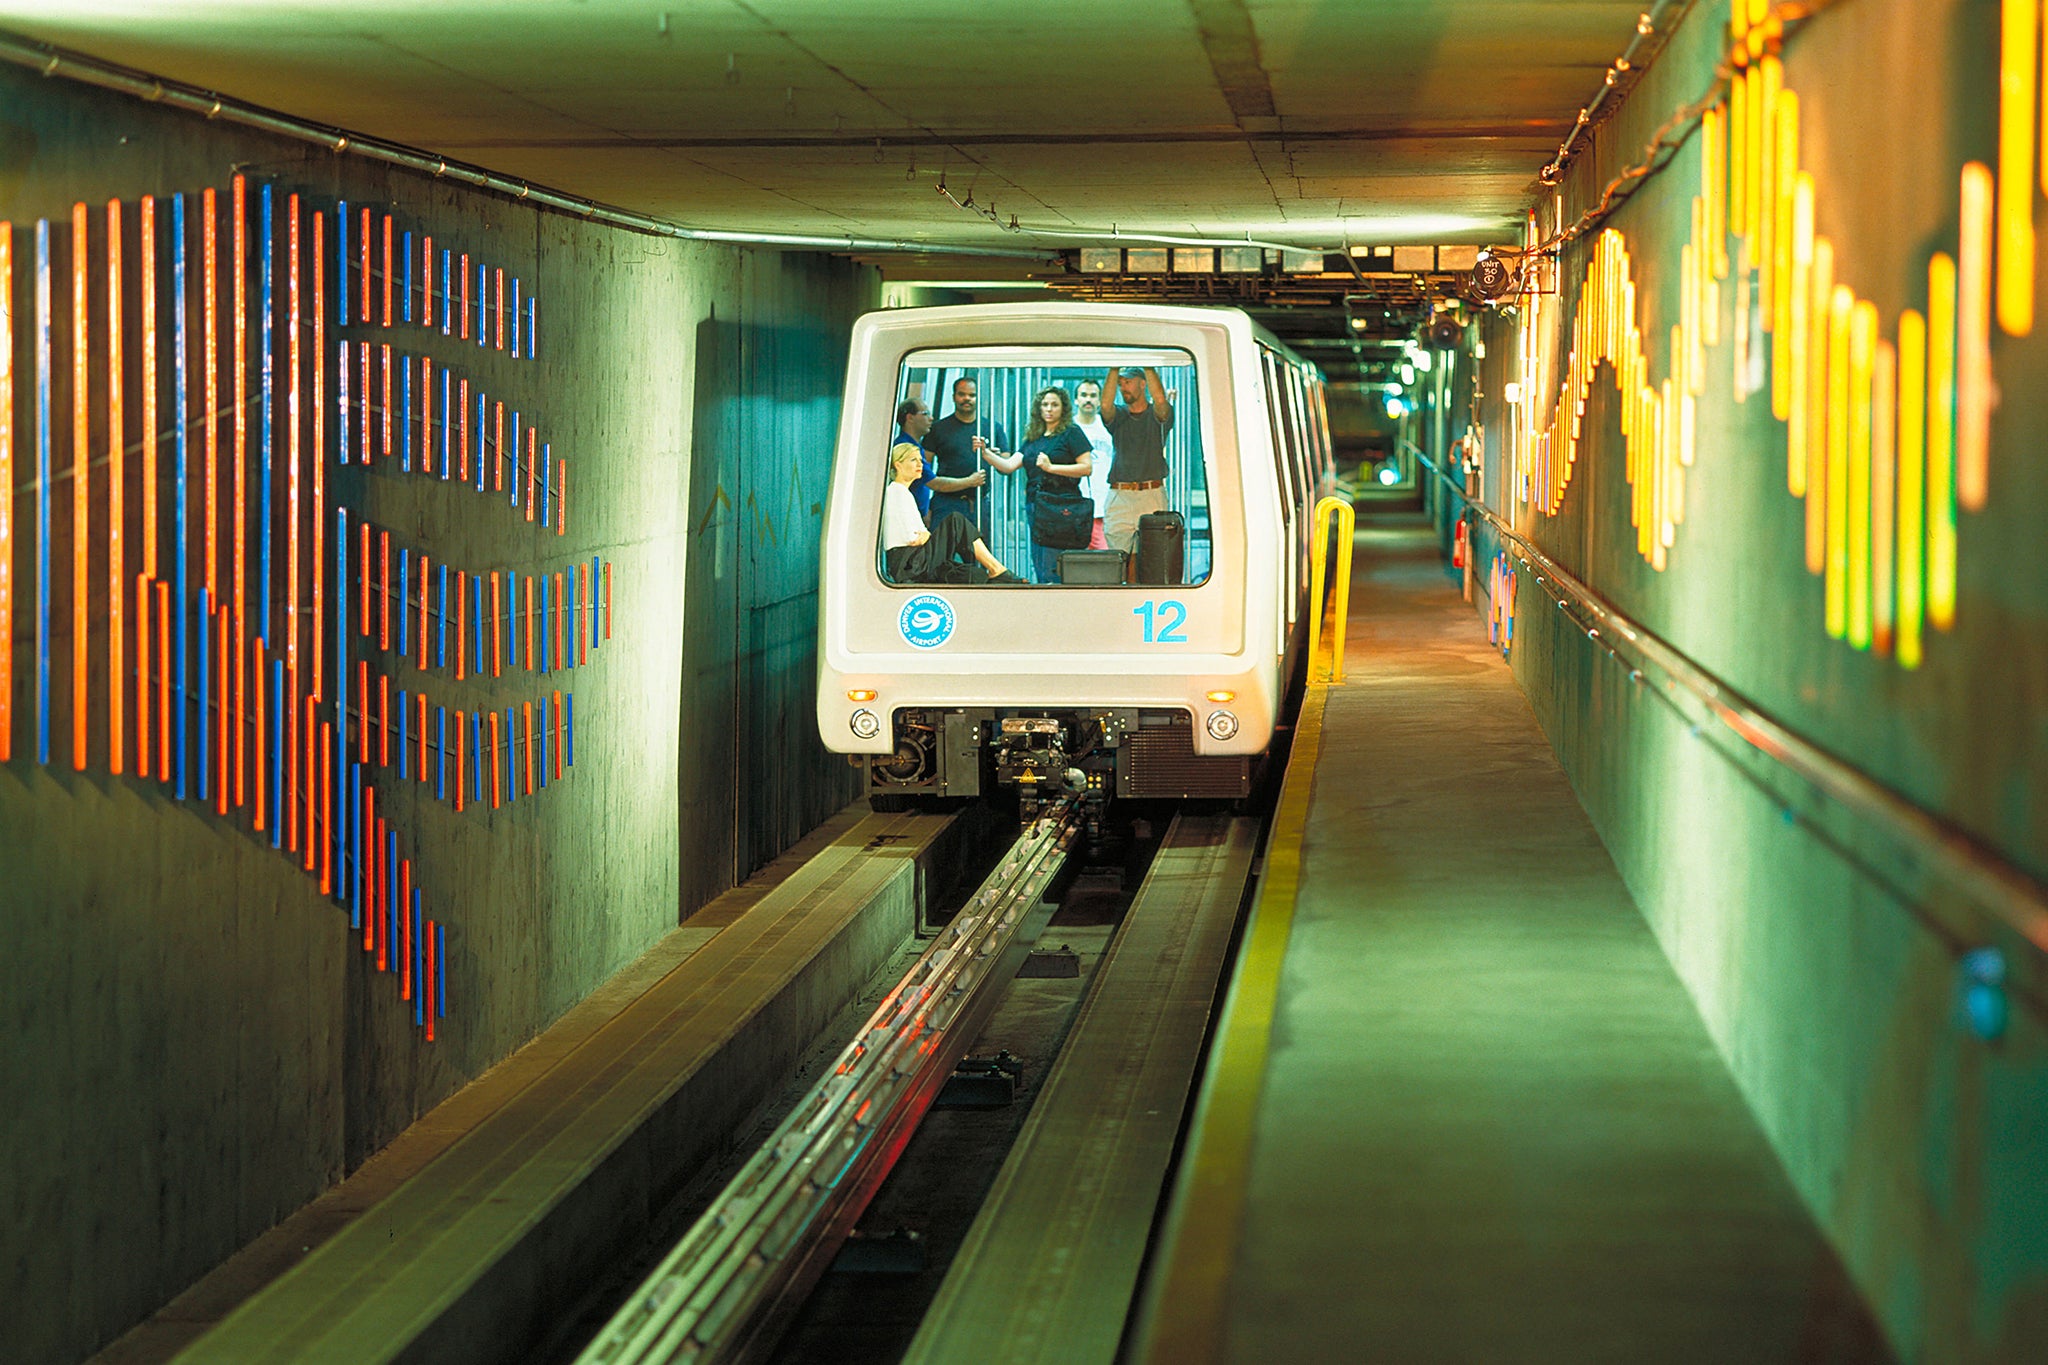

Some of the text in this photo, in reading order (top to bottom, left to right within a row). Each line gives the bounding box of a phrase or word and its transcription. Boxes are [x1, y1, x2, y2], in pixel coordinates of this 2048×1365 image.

[1481, 259, 1500, 268] UNIT
[1484, 267, 1498, 276] 30
[901, 596, 953, 634] DENVER INTERNATIONAL
[1133, 600, 1187, 643] 12
[910, 635, 942, 646] AIRPORT
